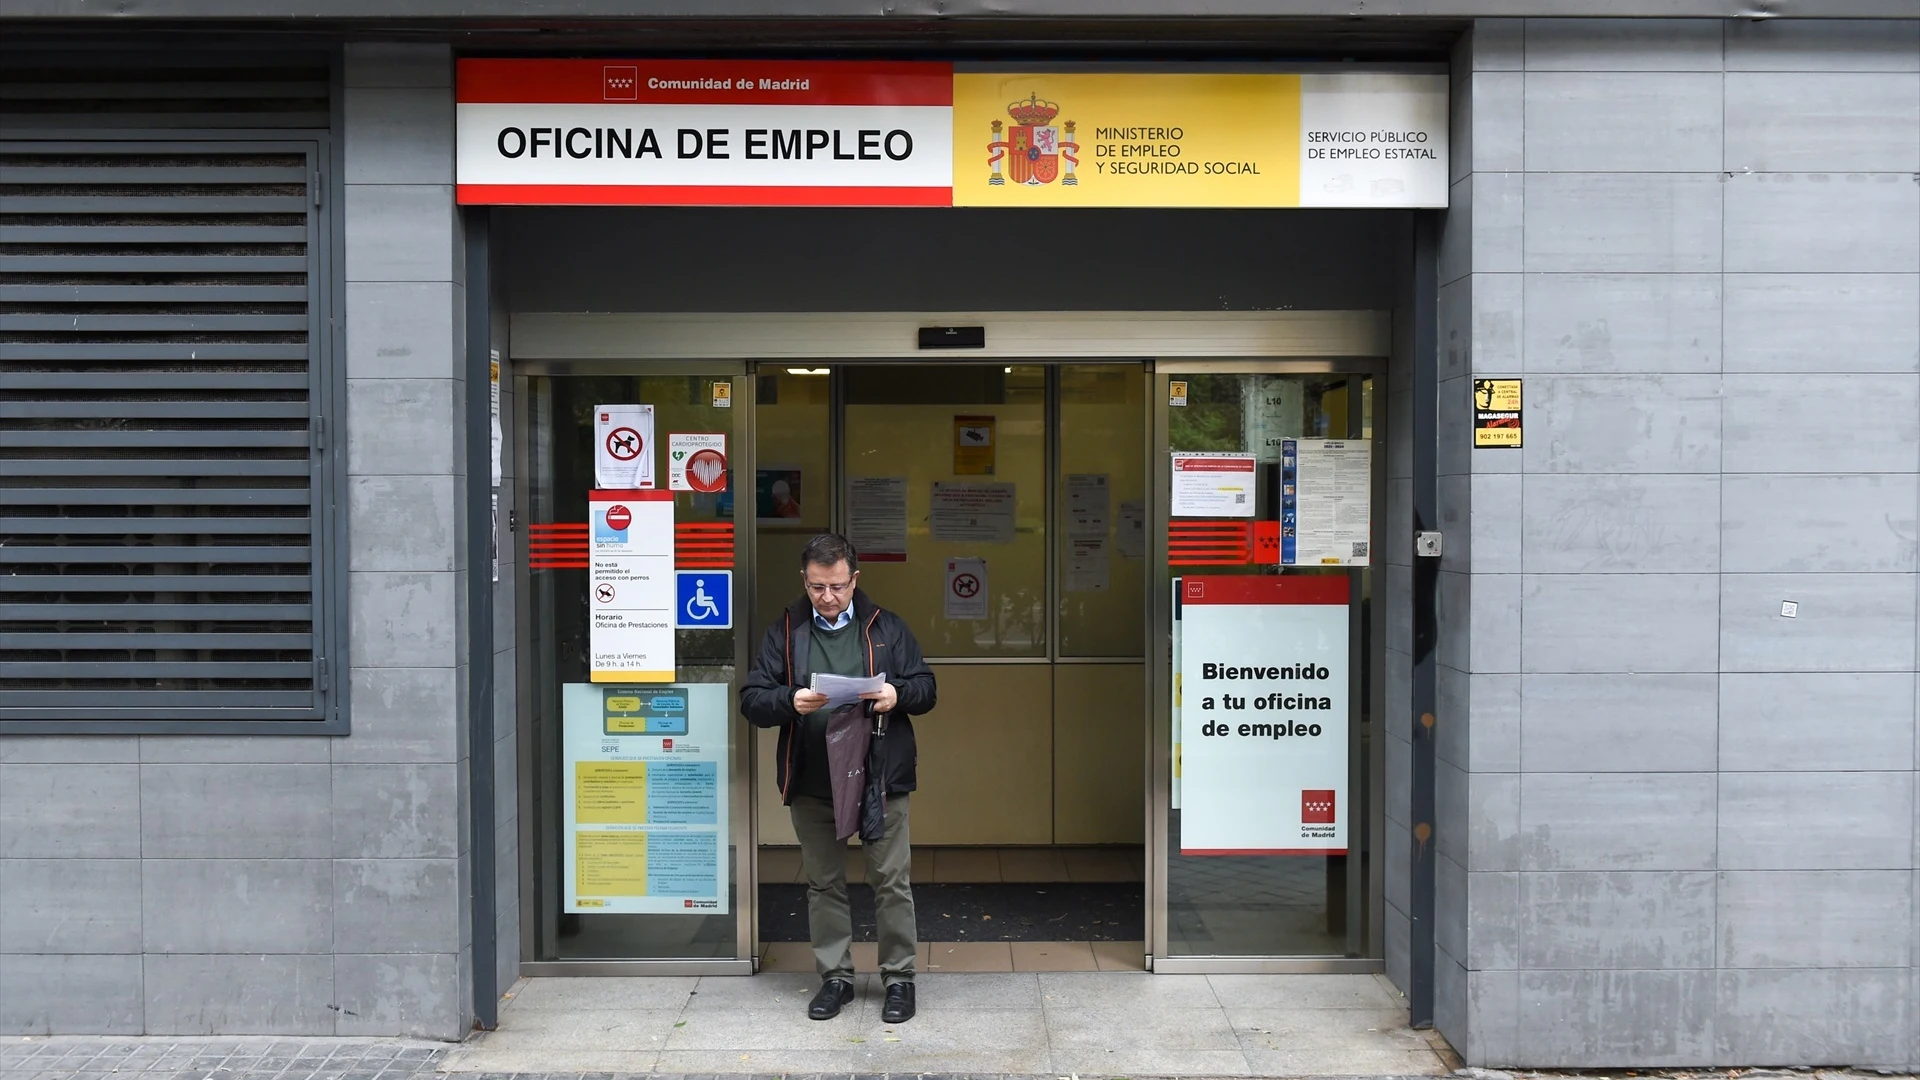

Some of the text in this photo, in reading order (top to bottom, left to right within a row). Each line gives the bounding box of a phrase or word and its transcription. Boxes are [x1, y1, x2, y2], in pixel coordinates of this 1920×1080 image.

[647, 77, 811, 91] Comunidad de Madrid
[1095, 126, 1184, 141] MINISTERIO
[1307, 128, 1428, 144] SERVICIO PÚBLICO
[496, 126, 914, 161] OFICINA DE EMPLEO
[1096, 144, 1181, 158] DE EMPLEO
[1308, 148, 1438, 160] DE EMPLEO ESTATAL
[1095, 161, 1261, 175] Y SEGURIDAD SOCIAL
[1266, 397, 1282, 405] L10
[596, 535, 619, 543] espacio
[1202, 662, 1330, 680] Bienvenido
[1201, 693, 1332, 710] a tu oficina
[1201, 720, 1322, 740] de empleo
